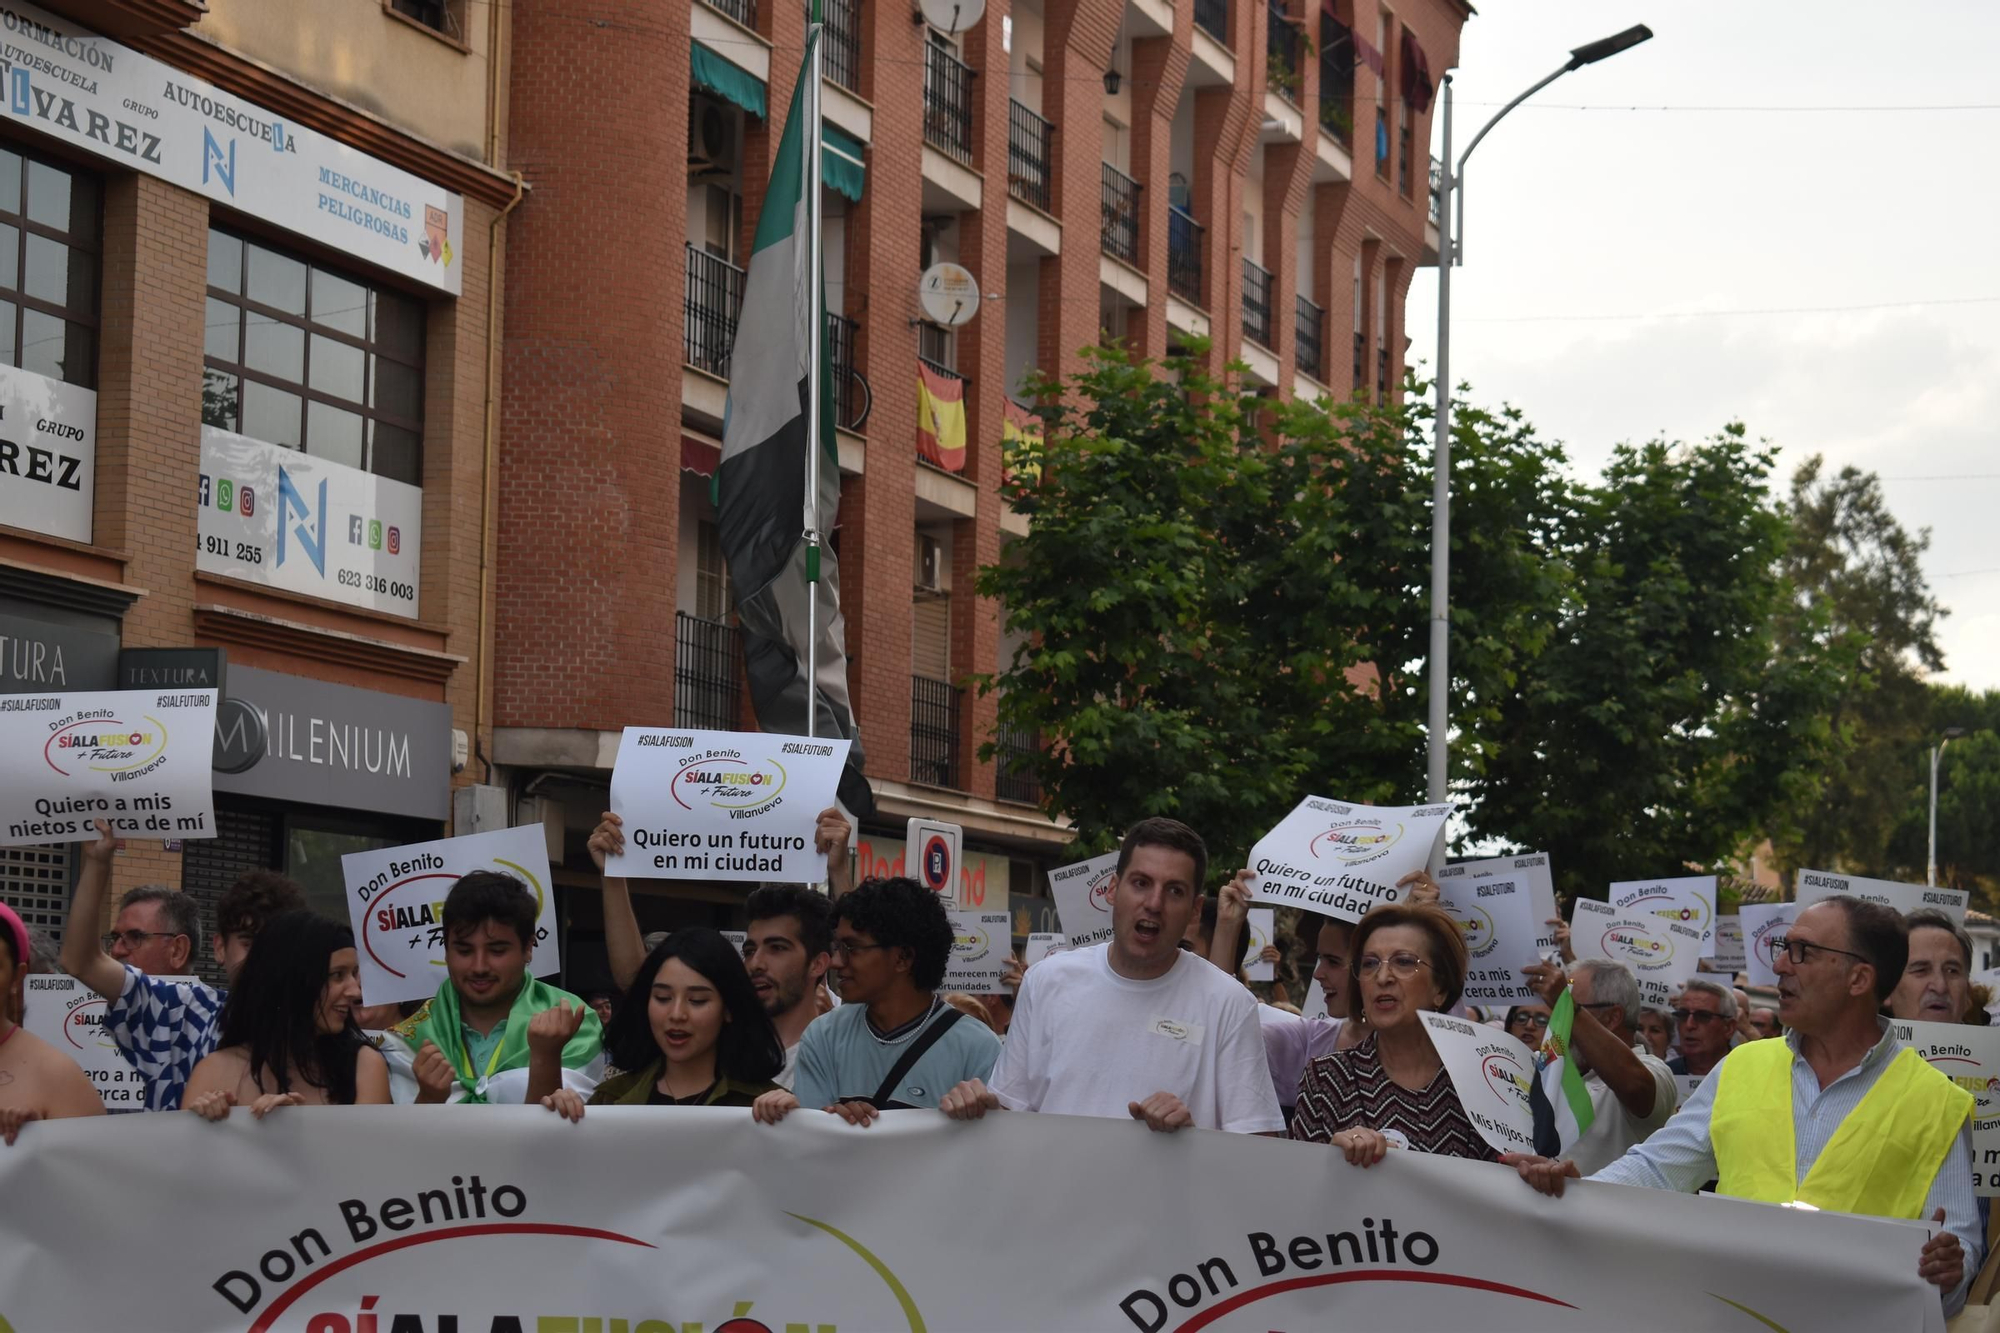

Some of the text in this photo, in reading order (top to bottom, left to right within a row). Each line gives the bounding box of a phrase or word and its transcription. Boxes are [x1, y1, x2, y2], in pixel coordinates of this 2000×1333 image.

[0, 7, 114, 73] ORMACIÓN
[0, 41, 98, 95] UTOESCUELA
[122, 97, 160, 120] GRUPO
[163, 81, 297, 154] AUTOESCUELA
[317, 165, 412, 220] MERCANCIAS
[317, 192, 409, 245] PELIGROSAS
[428, 211, 444, 227] ADR
[36, 418, 85, 442] GRUPO
[206, 535, 229, 557] 911
[236, 542, 262, 564] 255
[337, 567, 414, 601] 623 316 003
[128, 667, 209, 684] TEXTURA
[0, 698, 61, 712] #SIALAFUSION
[156, 694, 211, 708] #SIALFUTURO
[48, 708, 115, 732] Don Benito
[263, 708, 411, 779] ILENIUM
[637, 735, 694, 748] #SIALAFUSION
[781, 742, 833, 757] #SIALFUTURO
[89, 748, 136, 761] Futuro
[678, 748, 741, 767] Don Benito
[110, 754, 167, 783] Villanueva
[712, 785, 754, 798] Futuro
[35, 792, 172, 816] Quiero a mis
[729, 796, 783, 820] Villanueva
[9, 818, 77, 838] nietos
[145, 814, 171, 831] de
[177, 812, 204, 830] mí
[1330, 818, 1383, 829] Don Benito
[633, 828, 805, 850] Quiero un futuro
[653, 852, 782, 872] en mi ciudad
[358, 853, 444, 902] Don Benito
[1054, 864, 1090, 882] #SIALAFUSION
[1256, 858, 1398, 902] Quiero un futuro
[1477, 882, 1516, 897] #SIALFUTURO
[1804, 874, 1850, 891] #SIALAFUSION
[1262, 880, 1372, 916] en mi ciudad
[1616, 885, 1668, 907] Don Benito
[1923, 891, 1962, 907] #SIALFUTURO
[1579, 902, 1615, 916] #SIALAFUSION
[1606, 919, 1646, 929] Don Benito
[1752, 924, 1766, 938] Don
[1072, 934, 1091, 946] Mis
[949, 970, 988, 978] merecen
[1479, 971, 1487, 980] a
[1489, 967, 1511, 981] mis
[29, 979, 75, 990] #SIALAFUSION
[1465, 987, 1496, 998] cerca
[1499, 984, 1514, 998] de
[1646, 978, 1669, 993] mis
[66, 995, 85, 1010] Don
[1648, 993, 1665, 1006] de
[1476, 1045, 1490, 1057] Don
[1931, 1045, 1972, 1057] Benito
[114, 1070, 124, 1082] a
[1470, 1111, 1493, 1131] Mis
[1494, 1119, 1523, 1143] hijos
[212, 1226, 333, 1314] Don
[338, 1174, 528, 1242] Benito
[1118, 1217, 1440, 1333] Don Benito
